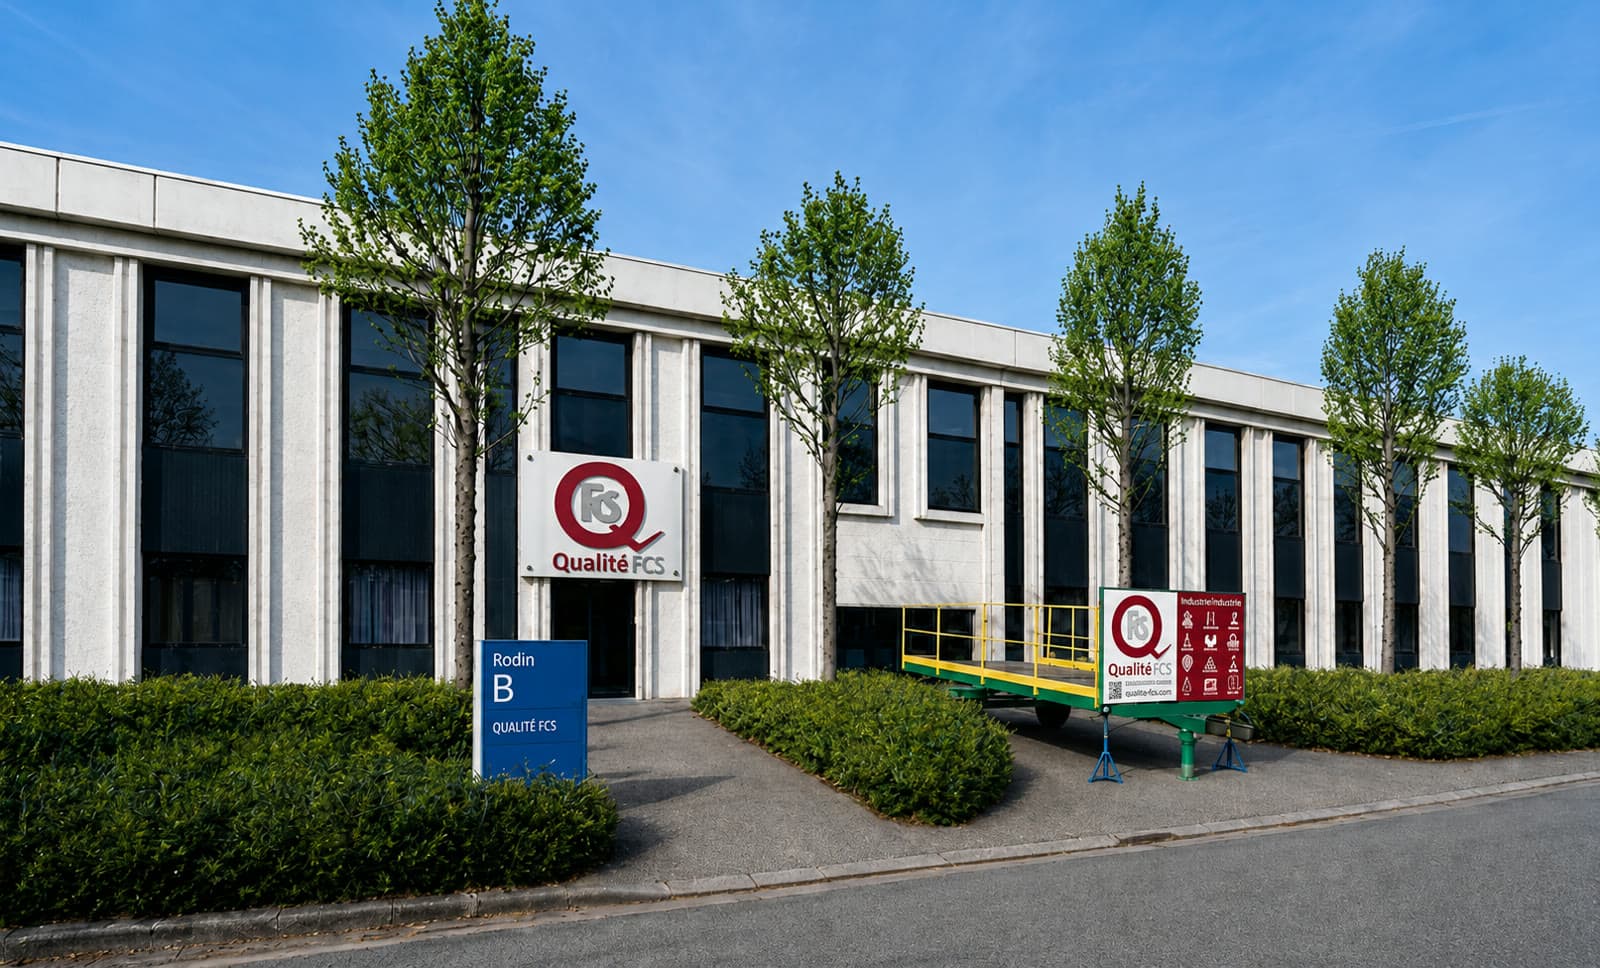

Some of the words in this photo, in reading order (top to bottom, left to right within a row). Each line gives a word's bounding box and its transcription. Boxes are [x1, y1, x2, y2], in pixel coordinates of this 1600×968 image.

[552, 552, 629, 573] Qualité
[632, 555, 665, 575] FCS
[492, 652, 535, 667] Rodin
[1108, 662, 1152, 678] Qualité
[1154, 662, 1172, 676] FCS
[493, 674, 514, 703] B
[492, 718, 536, 735] QUALITÉ
[538, 720, 557, 732] FCS
